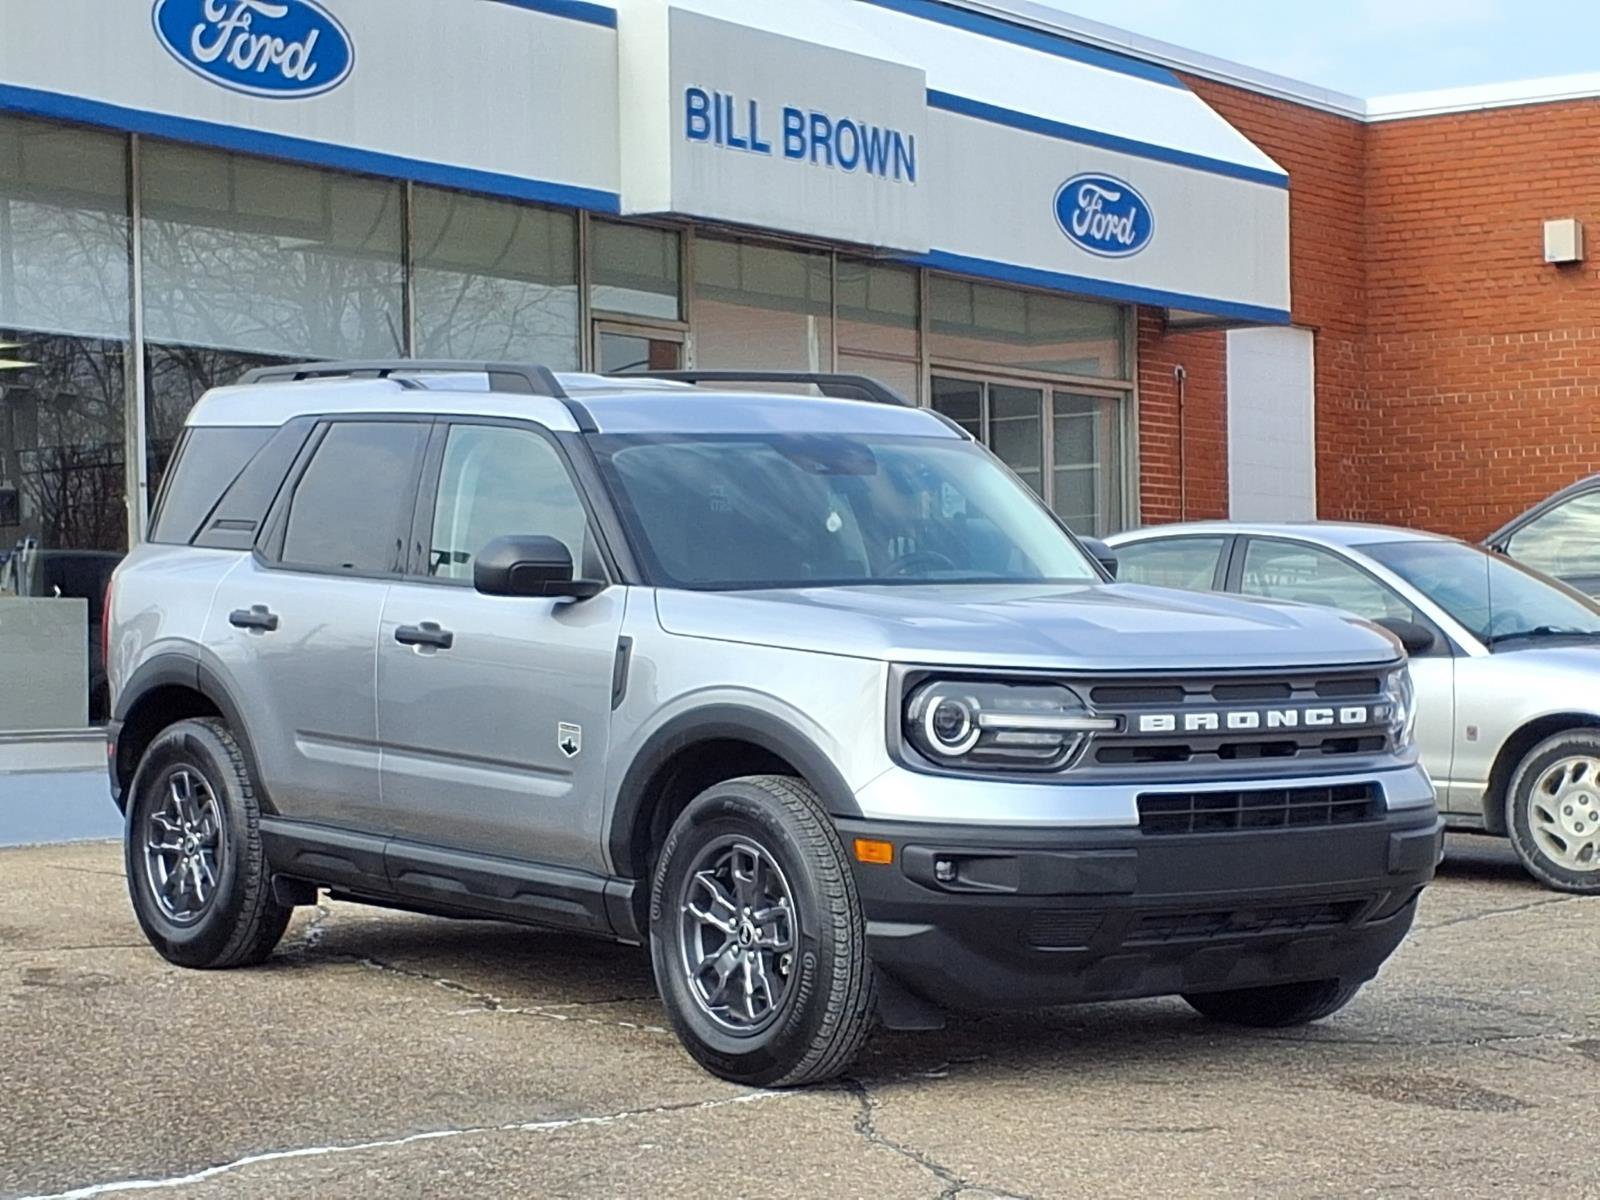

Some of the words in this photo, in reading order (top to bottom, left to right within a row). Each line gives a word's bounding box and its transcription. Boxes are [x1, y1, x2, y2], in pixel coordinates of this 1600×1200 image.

[191, 0, 321, 81] Ford
[685, 86, 771, 154] BILL
[783, 106, 916, 183] BROWN
[1072, 183, 1137, 246] Ford
[1139, 706, 1368, 732] BRONCO
